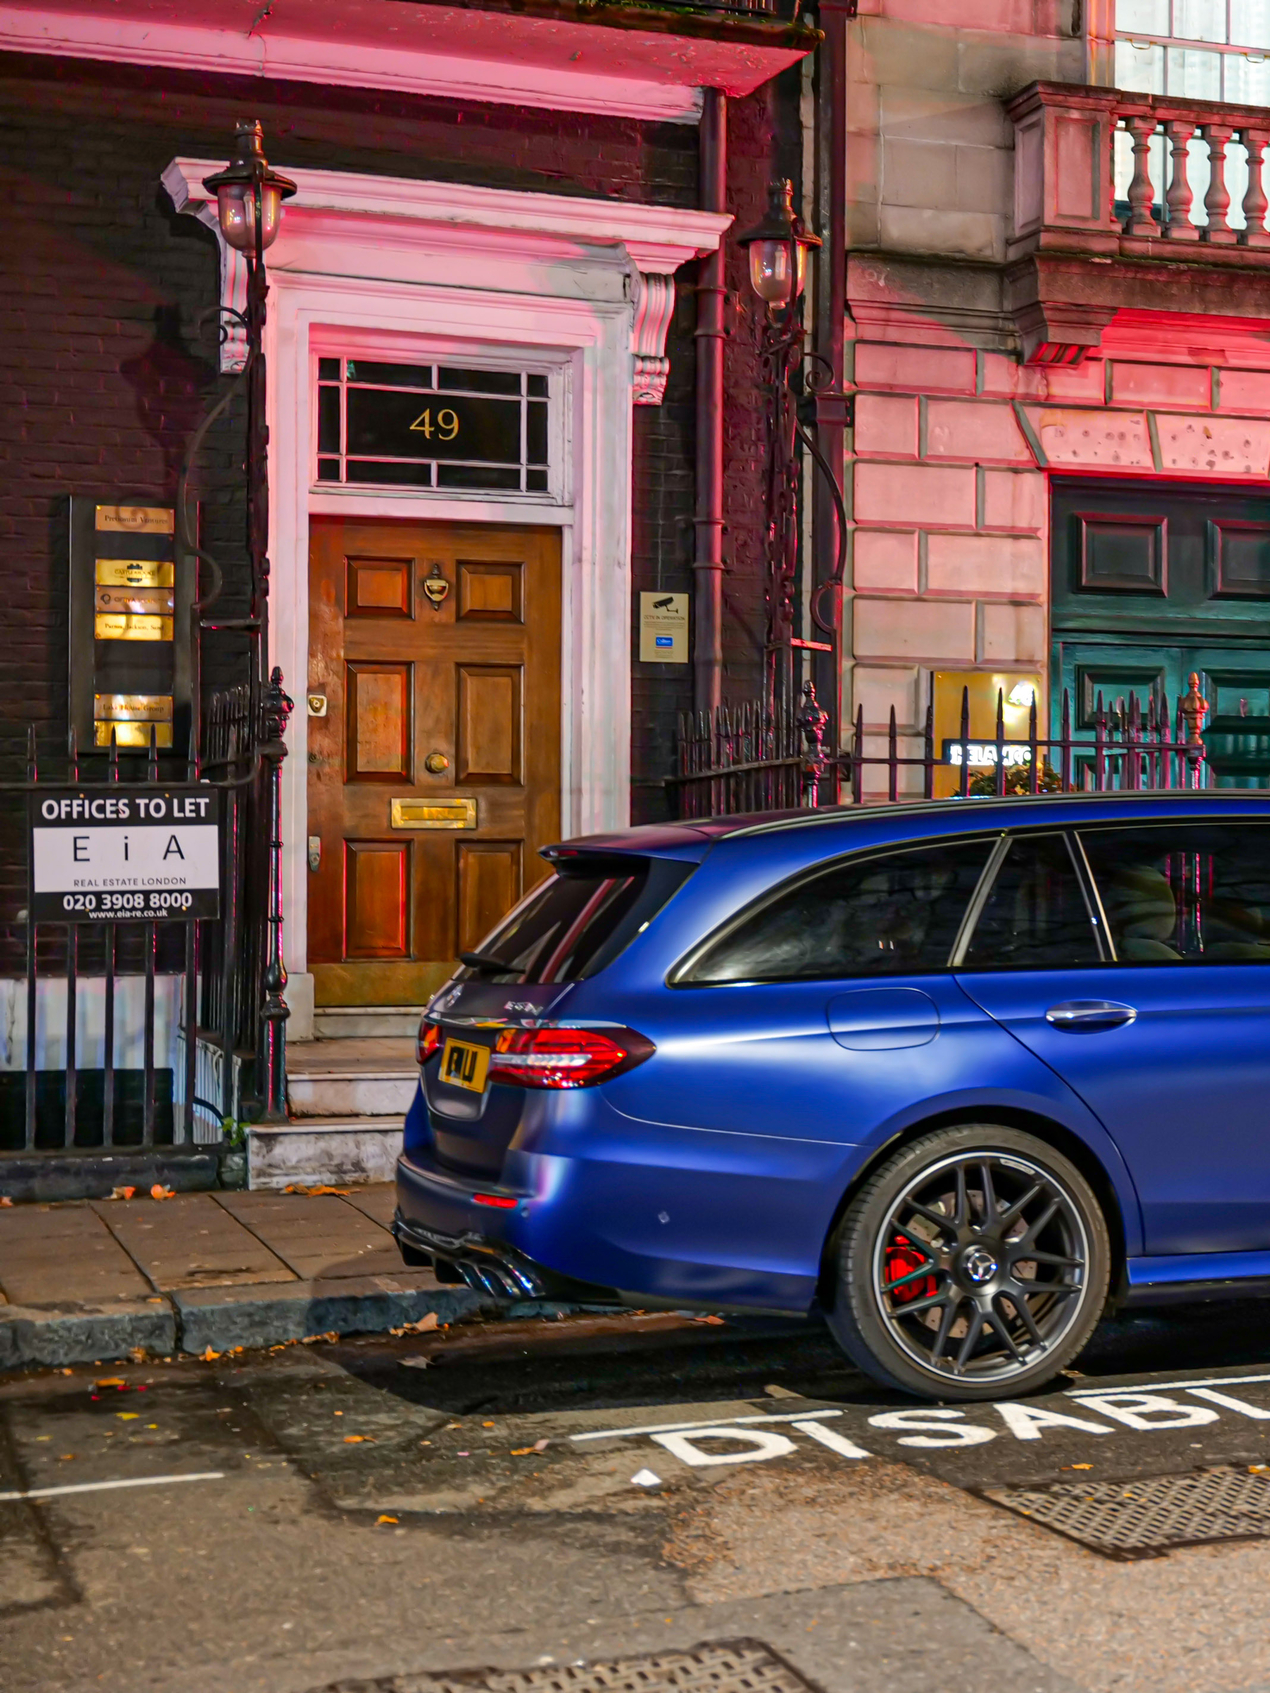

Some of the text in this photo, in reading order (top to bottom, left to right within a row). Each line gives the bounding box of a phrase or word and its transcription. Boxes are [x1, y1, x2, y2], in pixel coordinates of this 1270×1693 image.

[409, 408, 460, 441] 49
[41, 797, 210, 820] OFFICES TO LET
[73, 876, 187, 887] REAL ESTATE LONDON
[63, 892, 193, 911] 020 3908 8000
[89, 908, 168, 920] www.eia-re.co.uk
